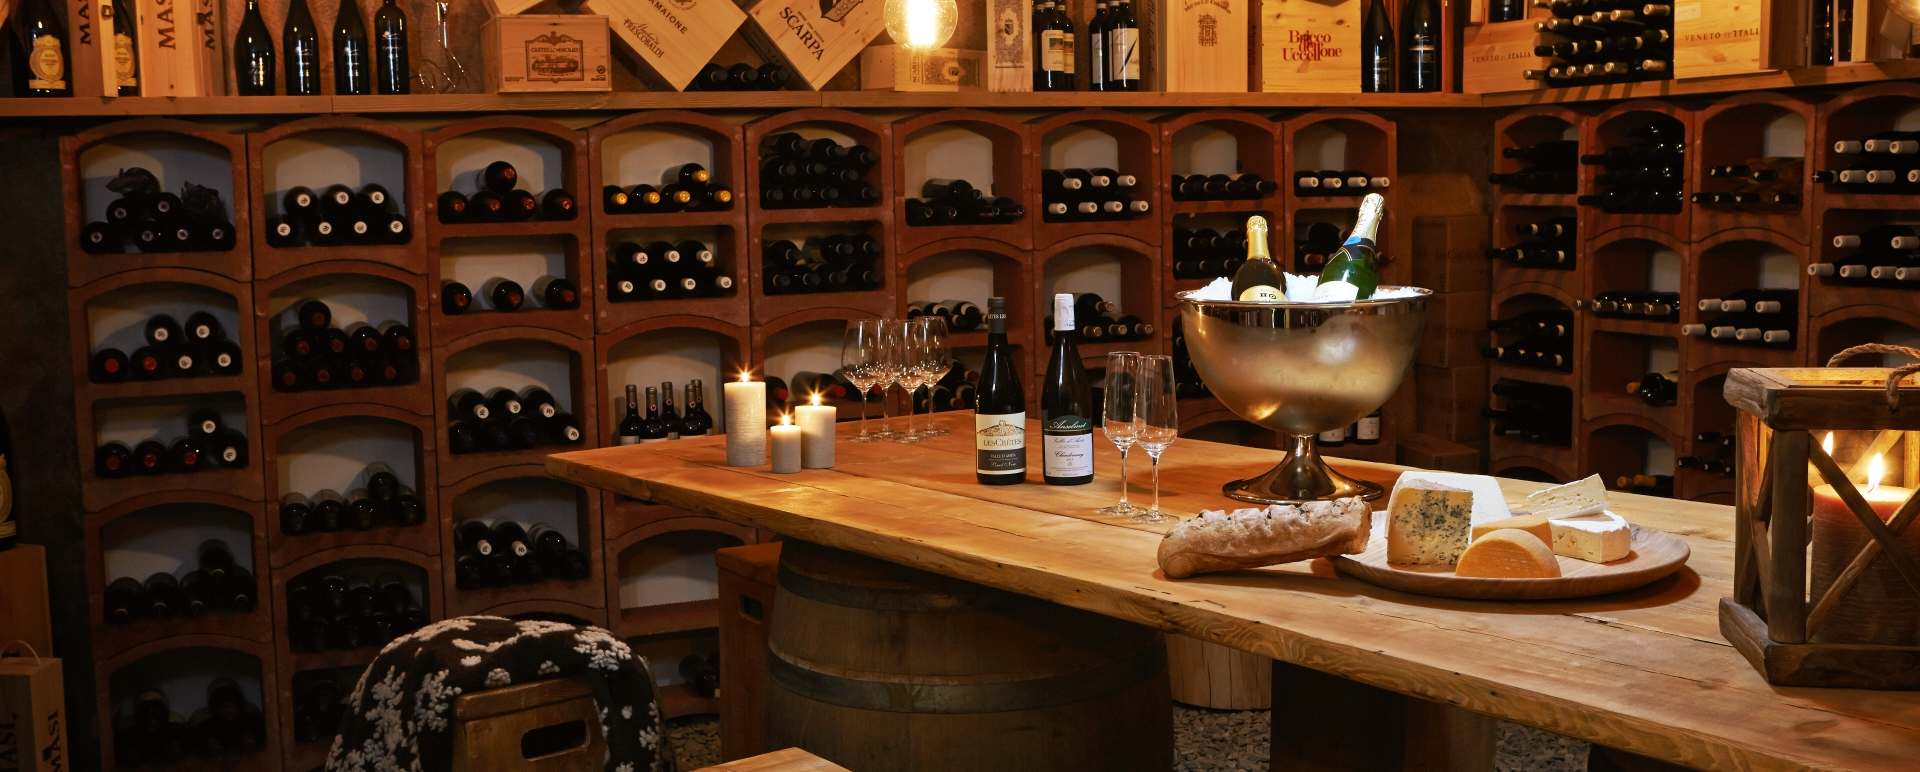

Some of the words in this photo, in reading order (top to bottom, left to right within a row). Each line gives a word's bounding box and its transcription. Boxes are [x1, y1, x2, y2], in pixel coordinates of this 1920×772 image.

[78, 0, 92, 46] MA
[779, 6, 825, 61] SCARPA
[1288, 29, 1332, 43] Bricco
[1684, 31, 1721, 42] VENETO
[1282, 43, 1343, 62] Uccellone
